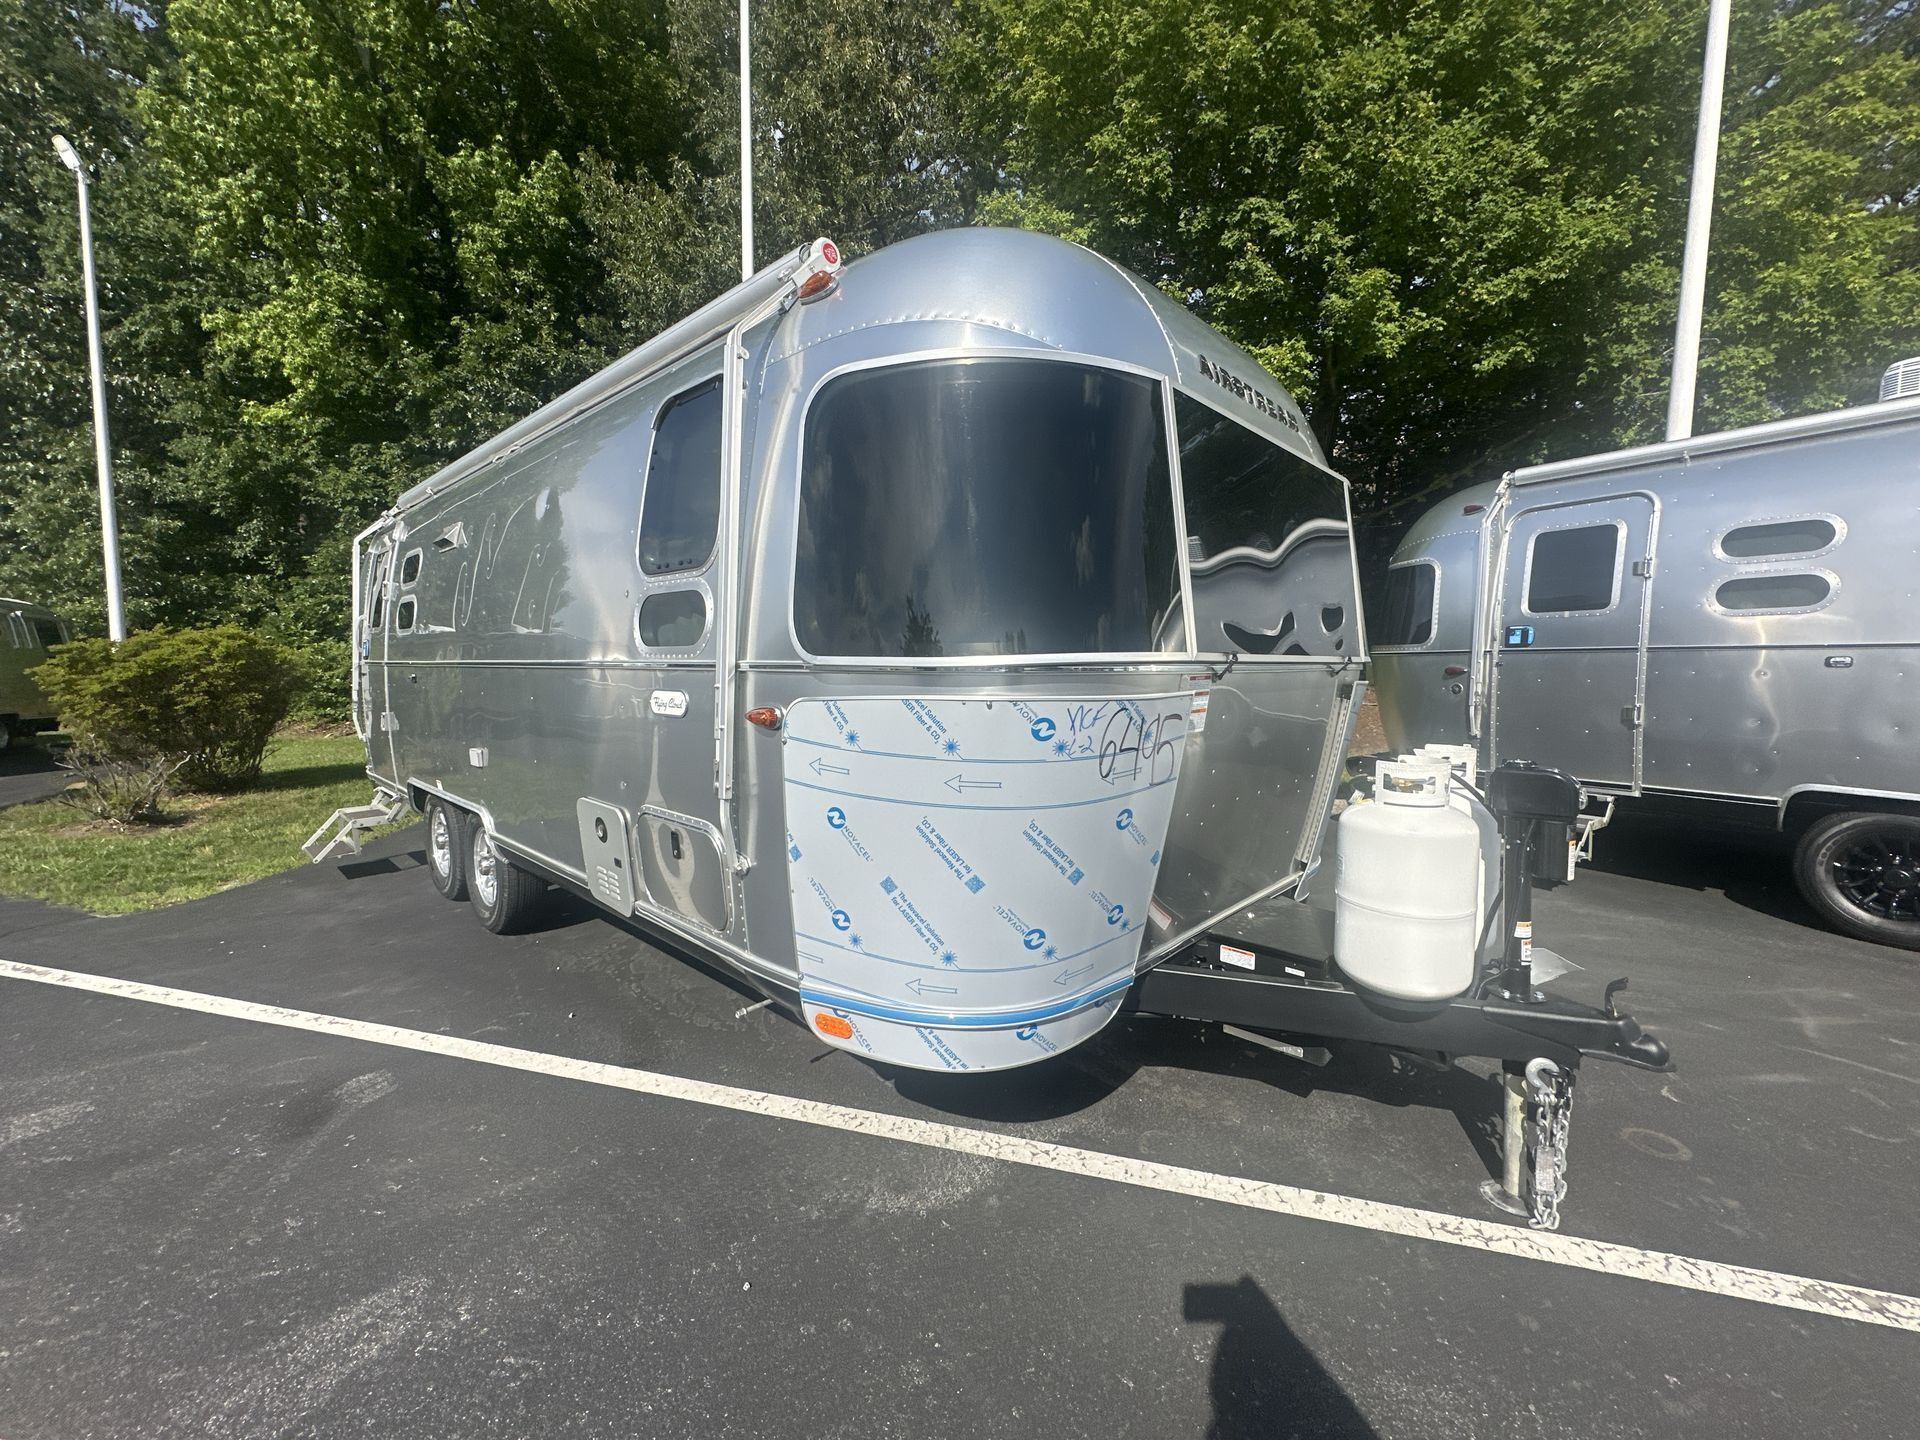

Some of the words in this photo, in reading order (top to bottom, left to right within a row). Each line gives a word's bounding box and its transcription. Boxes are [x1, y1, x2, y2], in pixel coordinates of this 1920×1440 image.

[1199, 353, 1299, 433] AIRSTREAM
[653, 697, 667, 711] Flying
[668, 698, 683, 709] Cloud
[912, 710, 928, 727] Fiber
[925, 709, 947, 734] Solution
[843, 825, 872, 862] NOVACEL
[916, 825, 936, 849] Solution
[934, 833, 948, 848] Fiber
[1022, 829, 1043, 851] Solution
[1042, 834, 1055, 849] Fiber
[1129, 821, 1147, 846] NOVACEL
[934, 847, 955, 870] Novacel
[946, 847, 965, 866] LASER
[1040, 848, 1060, 868] Novacel
[1052, 845, 1069, 862] LASER
[1067, 859, 1075, 868] for
[954, 868, 964, 880] The
[963, 864, 972, 874] for
[1059, 865, 1068, 876] The
[809, 877, 834, 912] NOVACEL
[1090, 890, 1112, 914] NOVACEL
[891, 896, 900, 907] for
[898, 905, 916, 925] LASER
[913, 923, 926, 938] Fiber
[898, 891, 907, 903] The
[906, 902, 927, 925] Novacel
[924, 923, 945, 946] Solution
[995, 905, 1027, 936] NOVACEL
[847, 1017, 873, 1054] NOVACEL
[932, 1034, 947, 1048] Fiber
[1034, 1032, 1058, 1052] NOVACEL
[932, 1047, 953, 1068] Novacel
[944, 1046, 962, 1064] LASER
